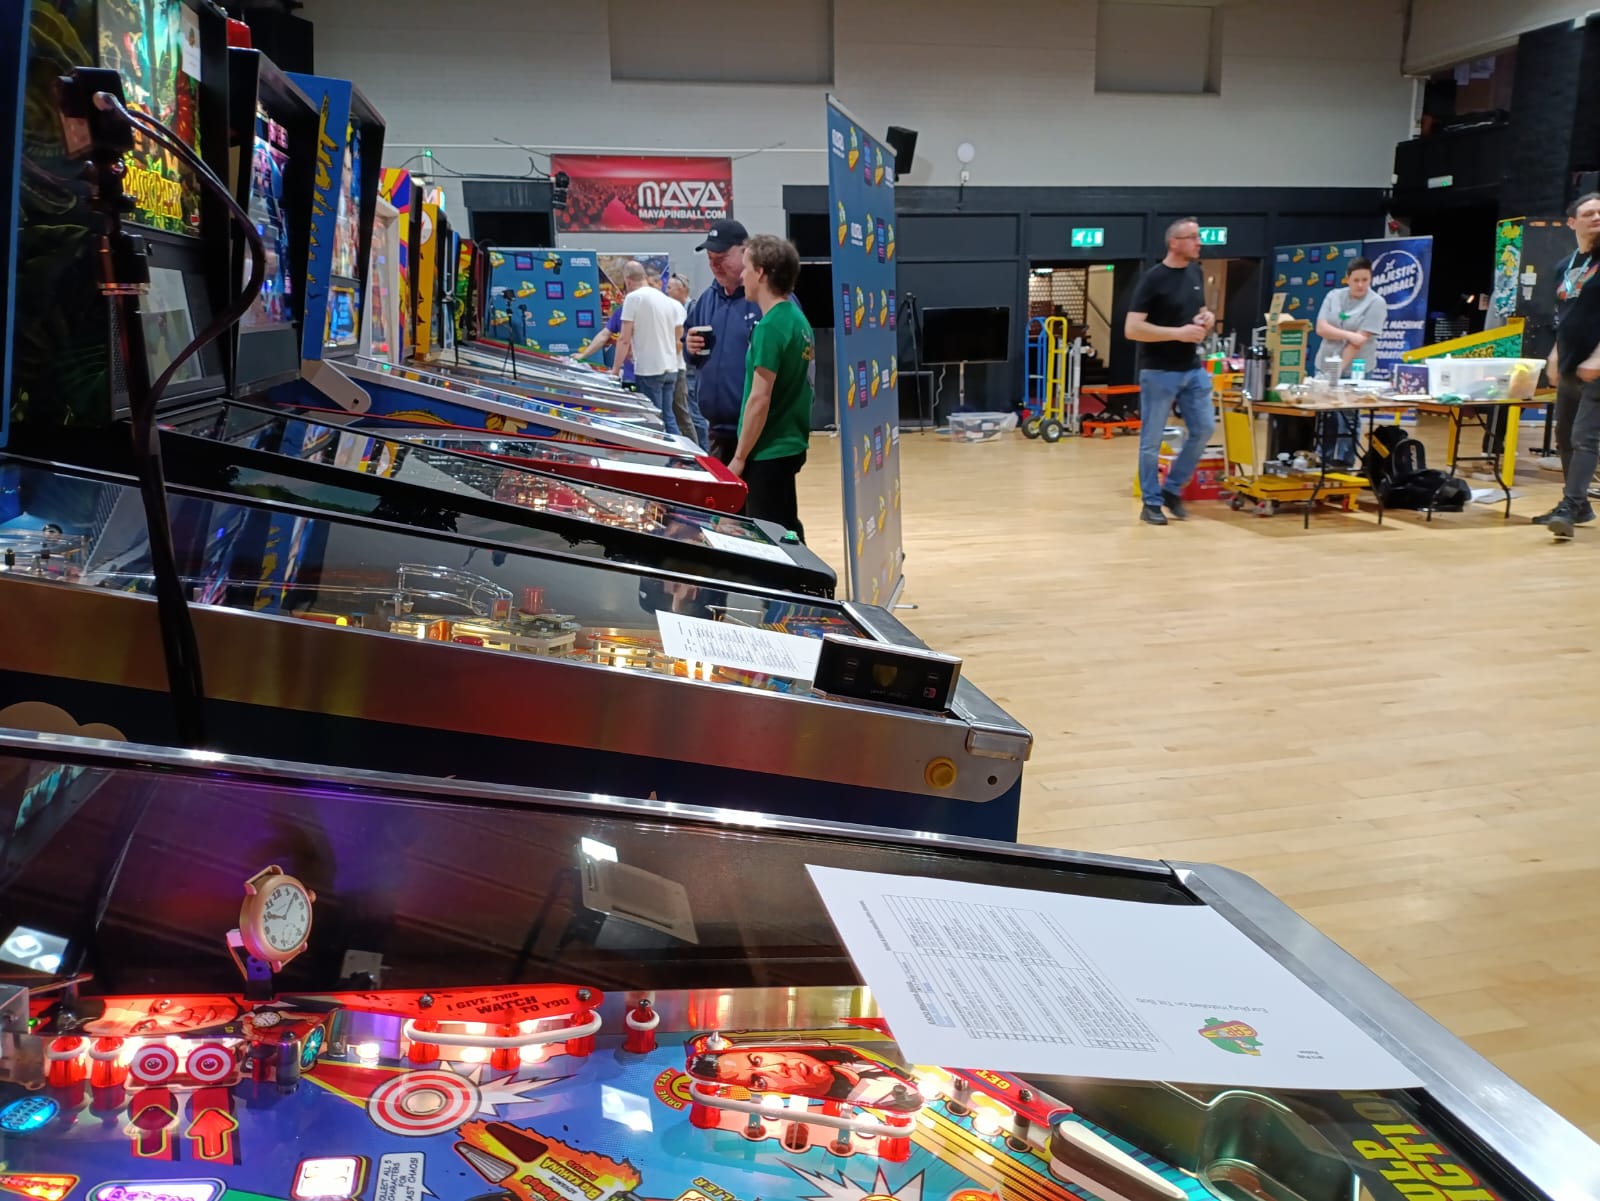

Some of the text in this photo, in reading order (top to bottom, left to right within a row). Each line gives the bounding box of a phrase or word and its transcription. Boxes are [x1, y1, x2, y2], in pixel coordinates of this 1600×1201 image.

[638, 209, 726, 219] MAYAPINBALL.COM
[1372, 263, 1417, 287] MAJESTIC
[456, 997, 487, 1009] GIVE
[492, 991, 520, 1001] THIS
[476, 996, 538, 1014] WATCH
[520, 998, 570, 1013] TO YOU
[656, 1070, 673, 1087] FAST
[976, 1069, 1011, 1091] GET
[657, 1090, 683, 1109] DRIVE
[383, 1166, 391, 1177] ALL
[541, 1158, 583, 1187] KAHUNA
[567, 1160, 599, 1181] BONUS
